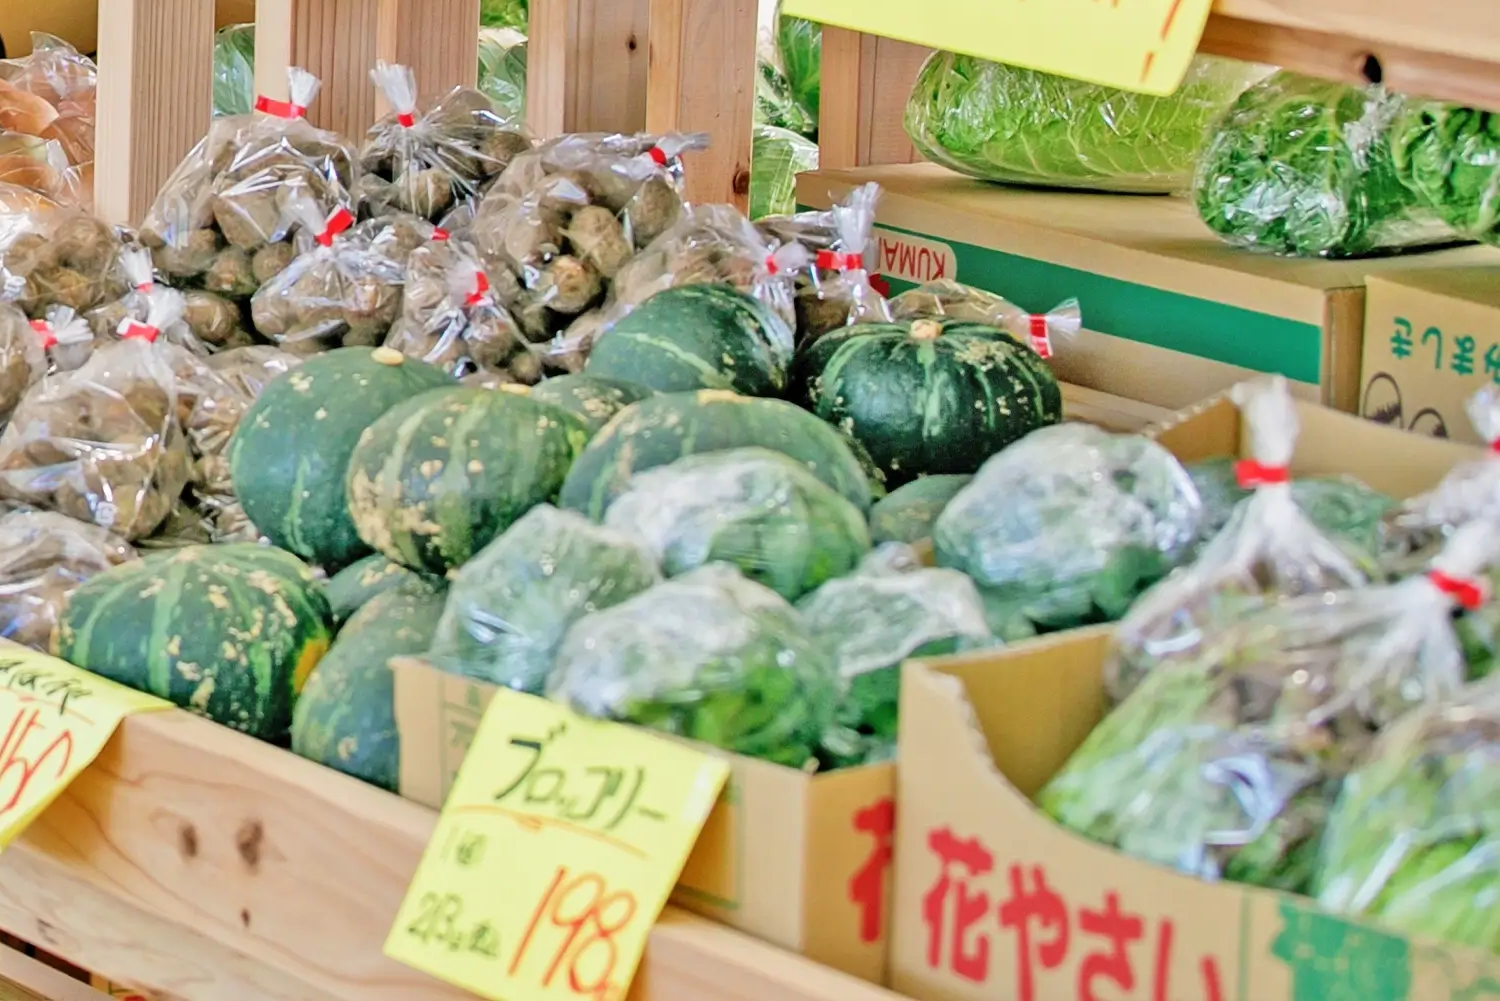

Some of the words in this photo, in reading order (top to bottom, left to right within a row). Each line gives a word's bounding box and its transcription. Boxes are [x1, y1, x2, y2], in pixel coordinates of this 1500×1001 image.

[878, 236, 947, 282] KUMA
[494, 721, 669, 832] ブロッコリー
[923, 825, 1226, 1001] 花やさい
